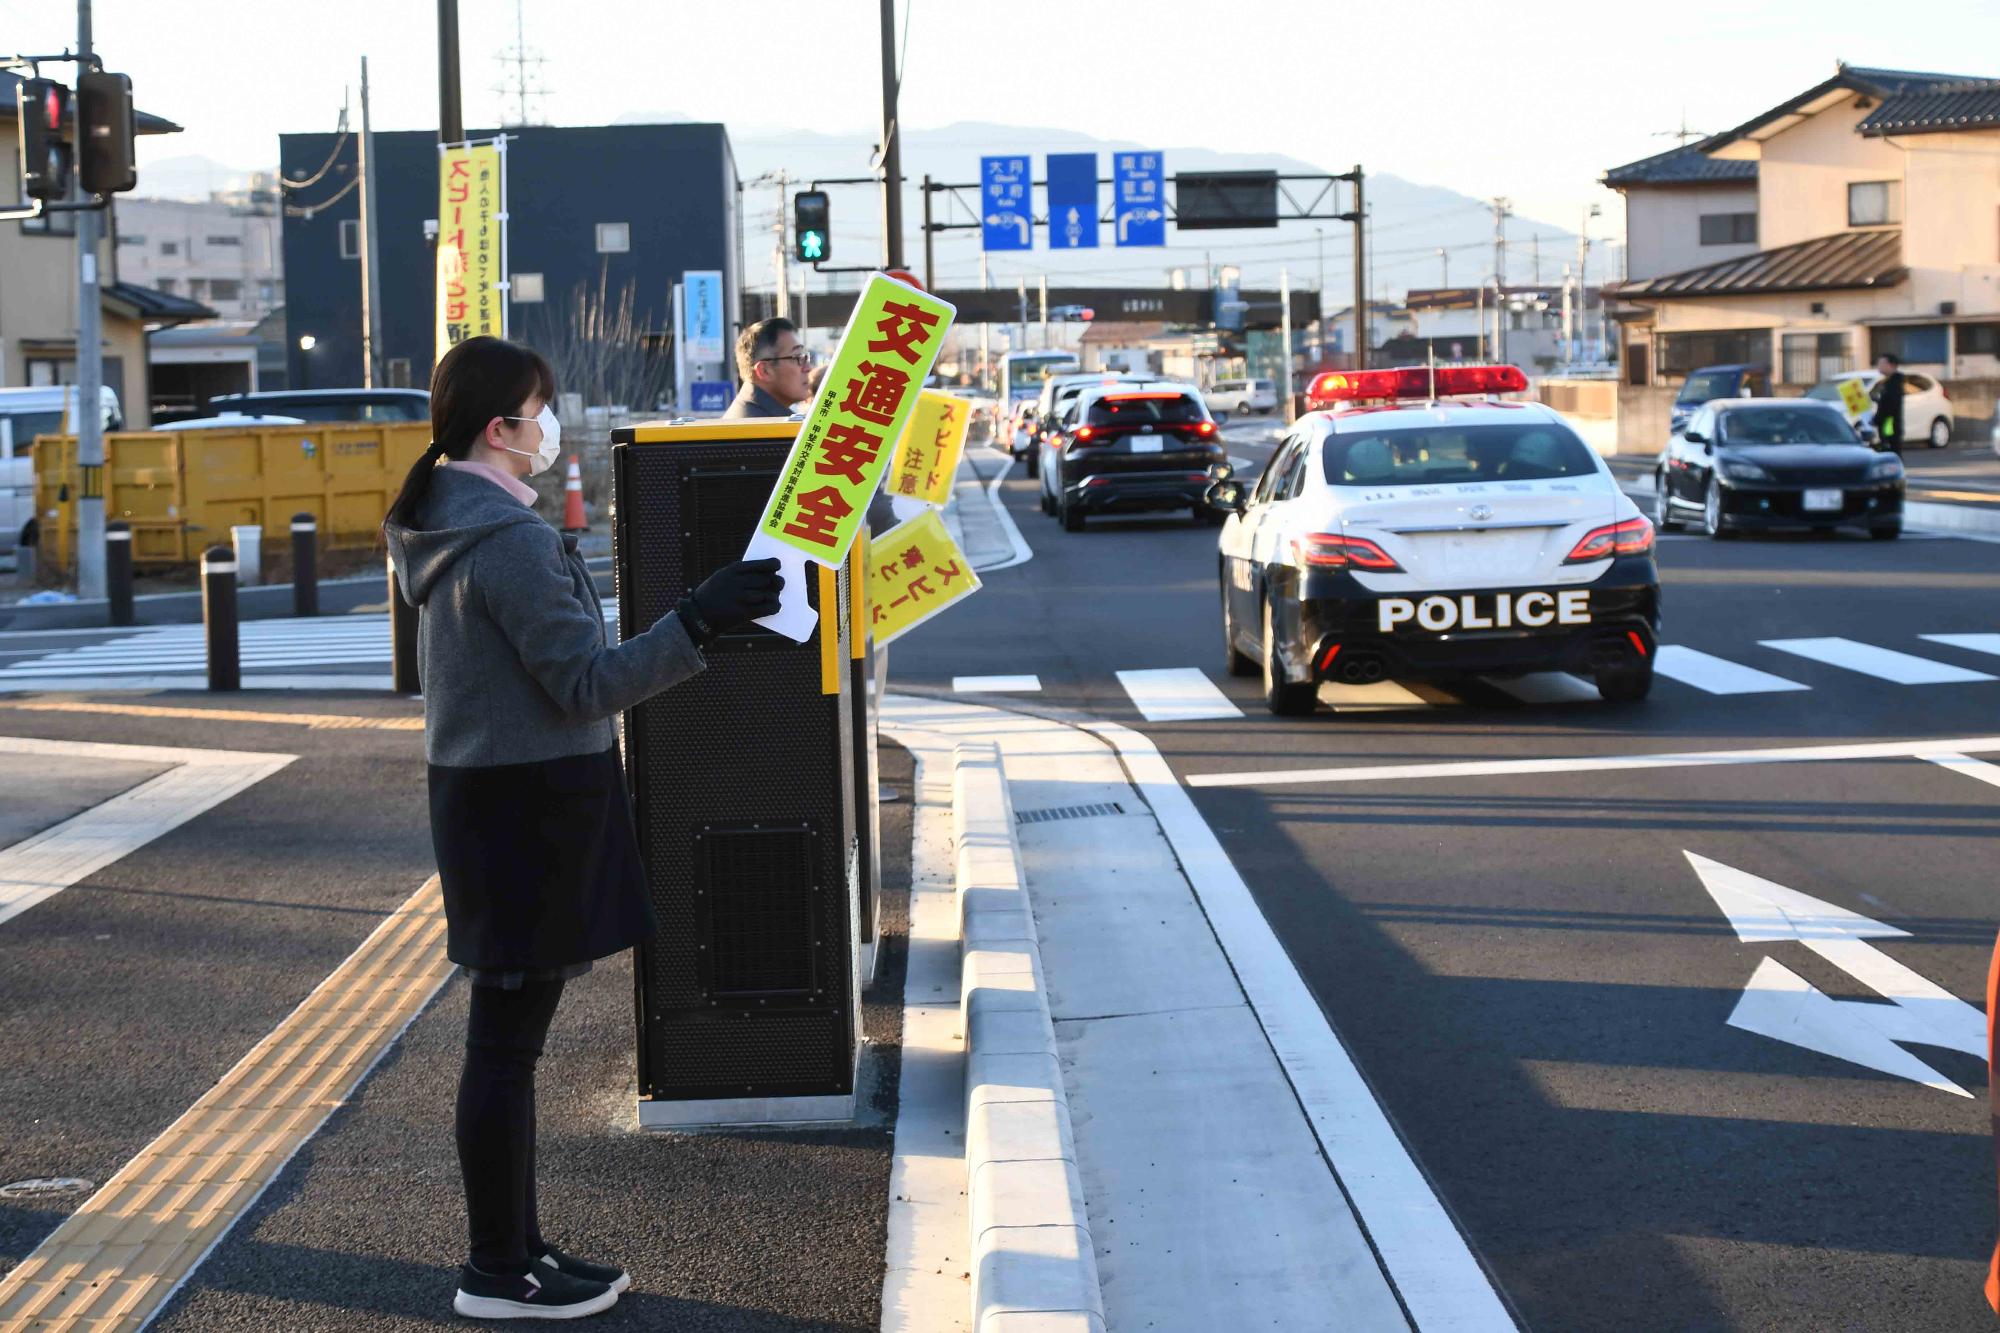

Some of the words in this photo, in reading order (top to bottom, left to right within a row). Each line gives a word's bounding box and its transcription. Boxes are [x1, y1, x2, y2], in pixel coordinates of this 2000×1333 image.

[782, 300, 940, 548] 交通安全
[924, 403, 956, 491] スピード
[899, 447, 925, 495] 注意
[871, 545, 925, 581] 落と
[1378, 589, 1592, 632] POLICE
